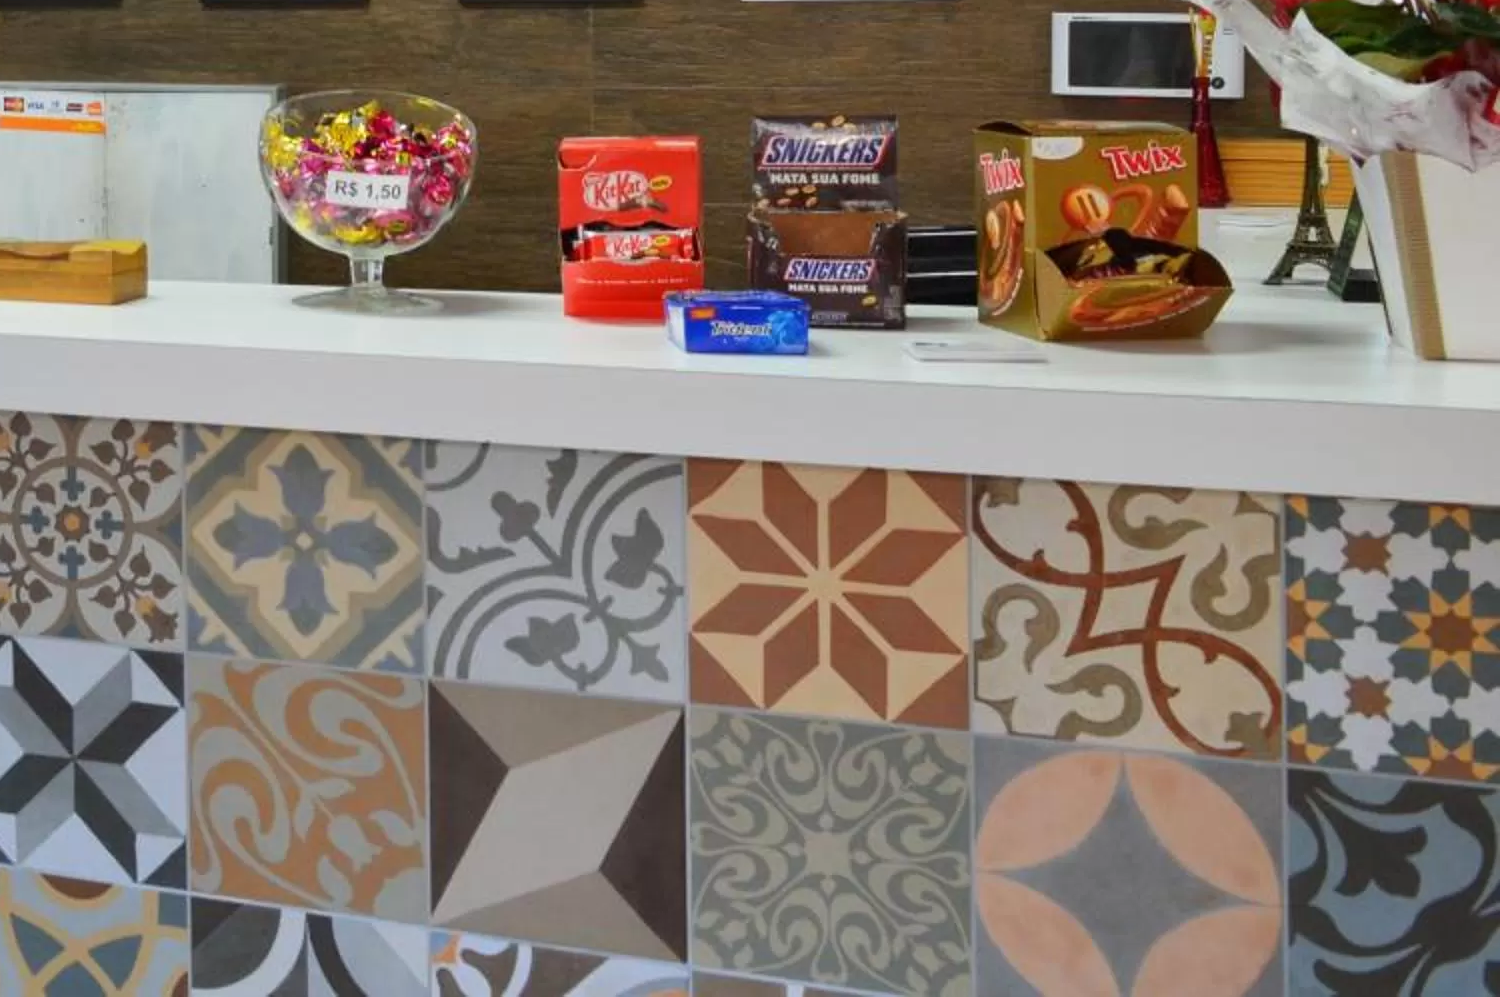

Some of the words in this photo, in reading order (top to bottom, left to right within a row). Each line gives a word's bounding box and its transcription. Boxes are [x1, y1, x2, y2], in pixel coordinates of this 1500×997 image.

[765, 136, 883, 164] SNICKERS
[1101, 139, 1187, 180] Twix
[334, 180, 359, 198] R$
[769, 172, 808, 185] MATA
[811, 172, 840, 185] SUA
[841, 172, 881, 185] FOME
[789, 259, 872, 280] SNICKERS
